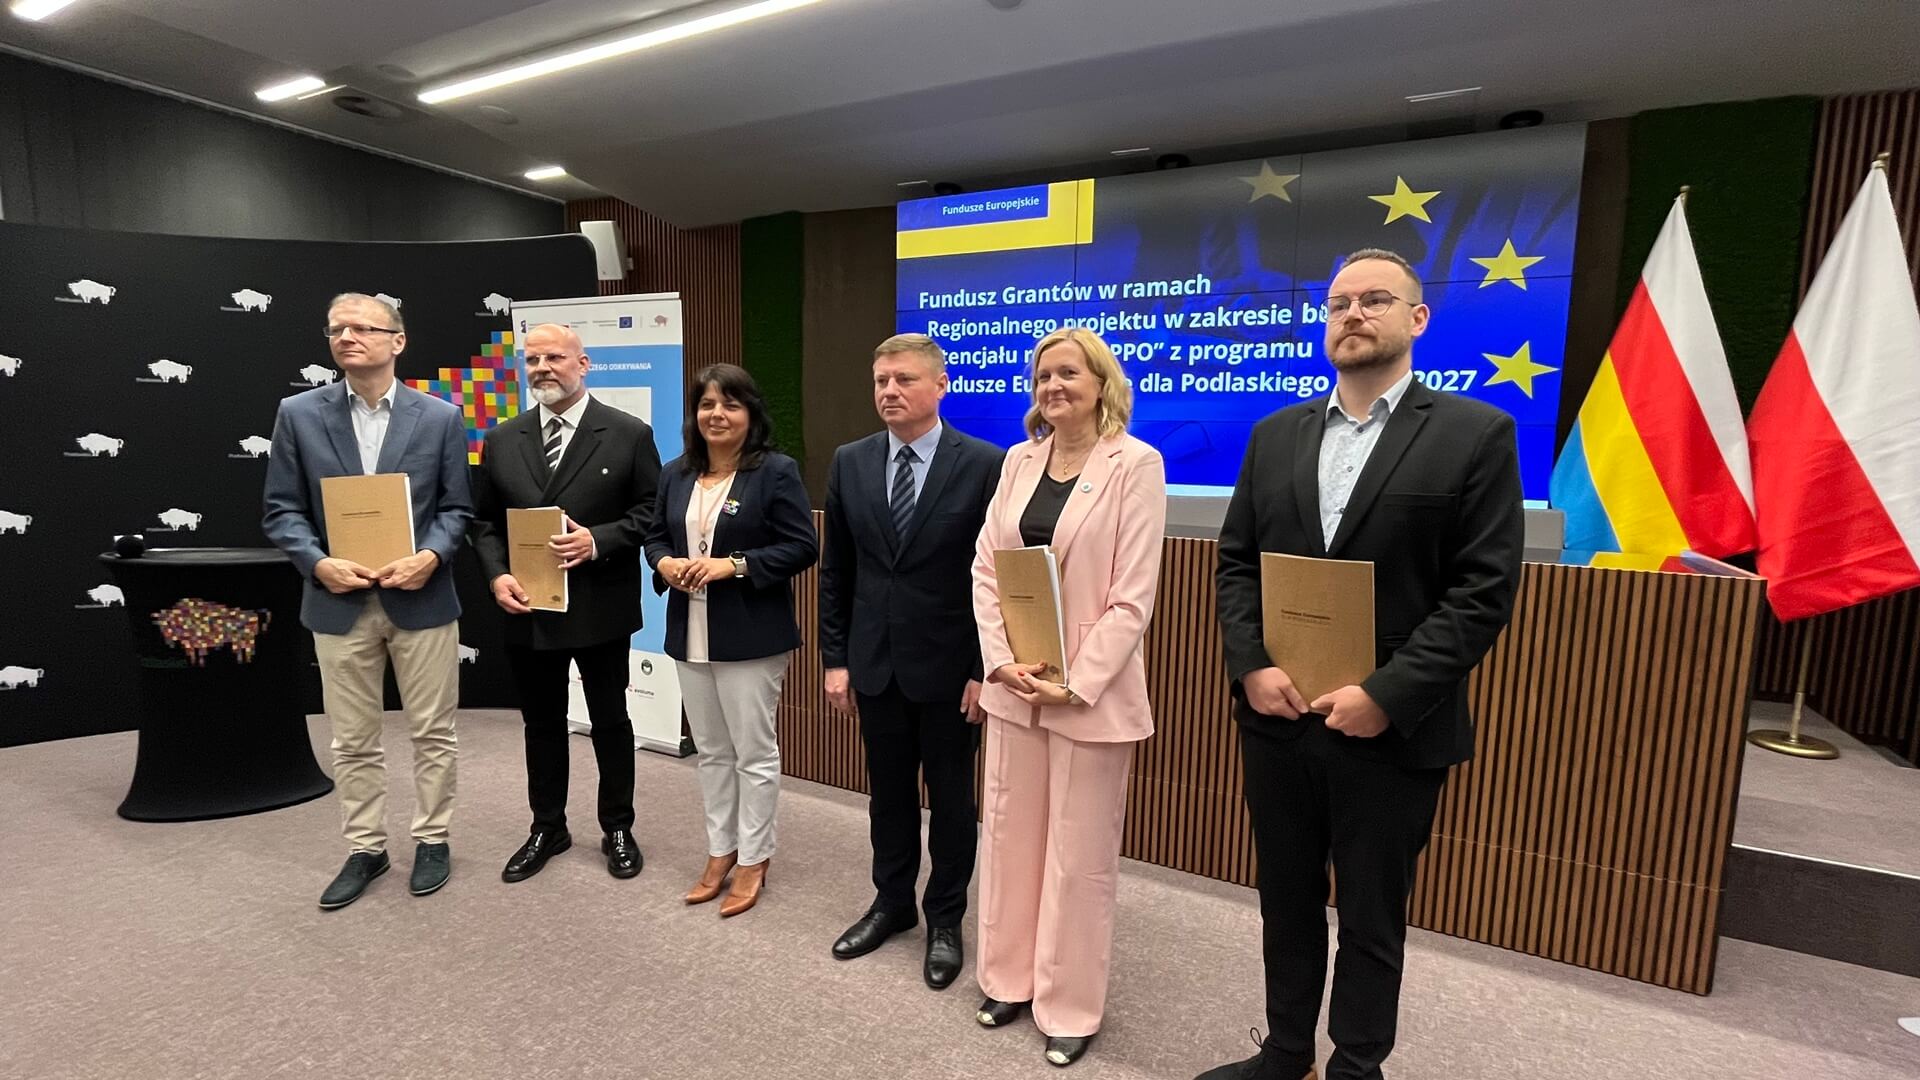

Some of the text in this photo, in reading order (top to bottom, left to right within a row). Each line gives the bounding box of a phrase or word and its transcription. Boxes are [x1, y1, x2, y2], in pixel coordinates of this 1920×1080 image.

[943, 196, 1040, 216] Fundusze Europejskie
[919, 274, 1211, 309] Fundusz Grantów w ramach
[927, 316, 1057, 341] Regionalnego
[1063, 311, 1156, 337] projektu
[1164, 313, 1184, 328] w
[1189, 304, 1293, 329] zakresie
[1170, 345, 1181, 361] z
[1189, 341, 1313, 366] programu
[1140, 372, 1173, 393] dla
[1181, 372, 1330, 397] Podlaskiego
